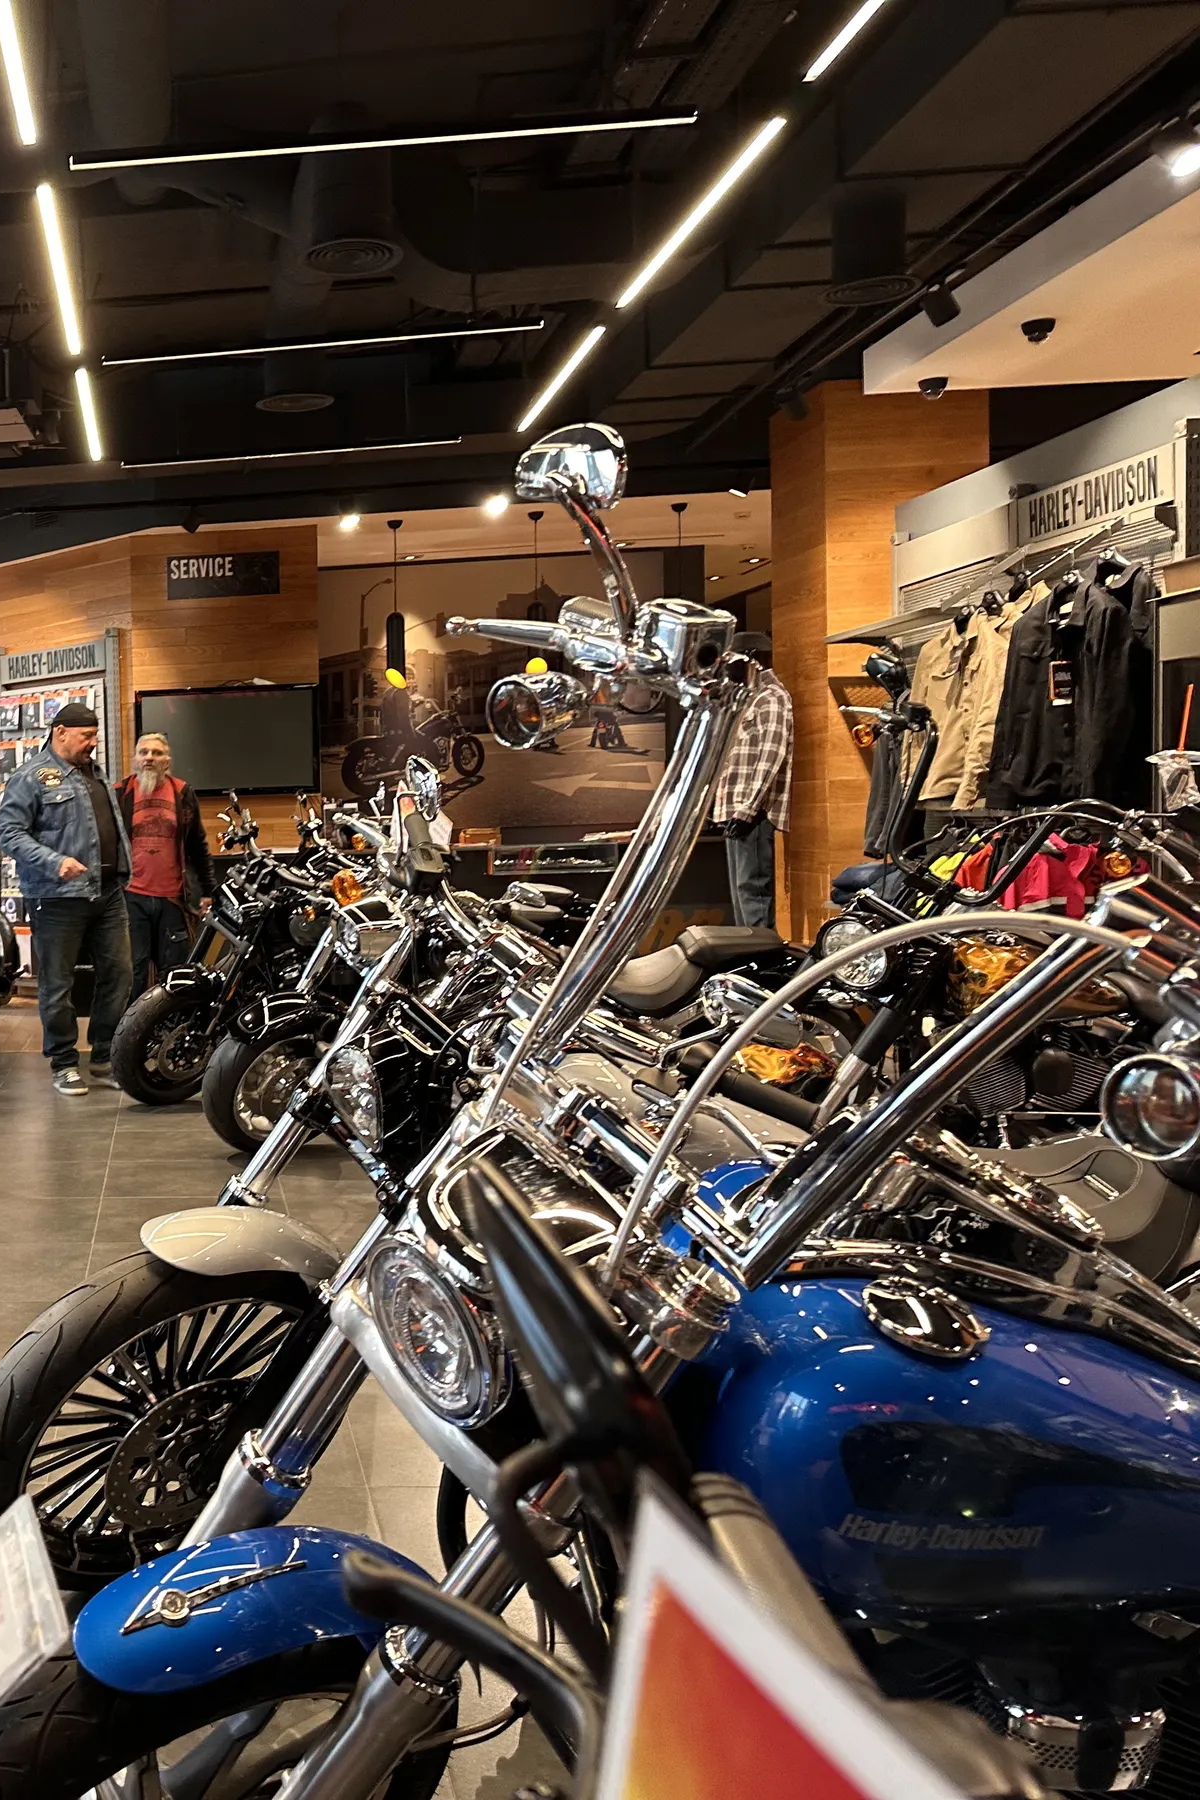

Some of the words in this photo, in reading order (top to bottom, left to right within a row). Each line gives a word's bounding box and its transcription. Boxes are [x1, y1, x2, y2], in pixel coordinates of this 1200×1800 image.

[1029, 455, 1158, 538] HARLEY-DAVIDSON
[170, 557, 234, 580] SERVICE
[8, 644, 95, 679] HARLEY-DAVIDSON
[839, 1513, 1044, 1550] Harley-Davidson
